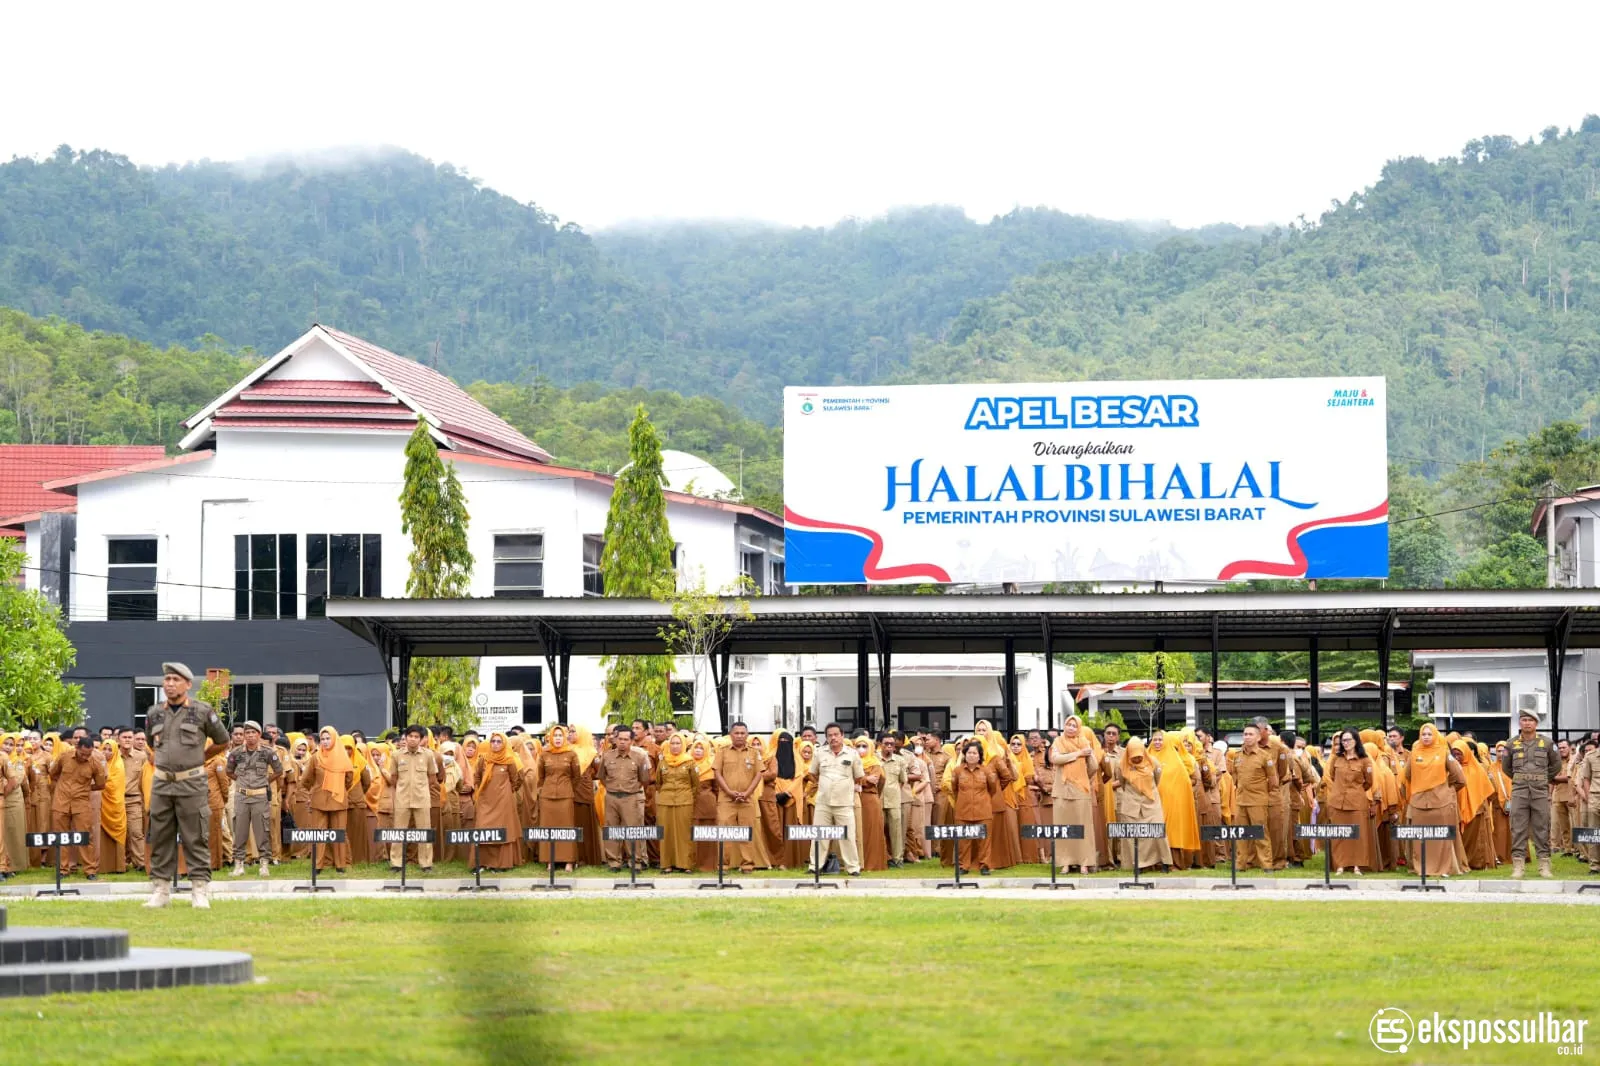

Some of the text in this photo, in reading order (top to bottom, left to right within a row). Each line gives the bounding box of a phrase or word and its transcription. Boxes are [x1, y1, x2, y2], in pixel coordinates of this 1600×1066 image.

[1334, 389, 1359, 398] MAJU
[1327, 398, 1375, 407] SEJAHTERA
[964, 395, 1200, 430] APEL BESAR
[1033, 441, 1134, 459] Dirangkaikan
[903, 507, 1266, 524] PEMERINTAH PROVINSI SULAWESI BARAT
[292, 830, 337, 841] KOMINFO
[381, 830, 428, 841] DINAS ESDM
[451, 830, 502, 843] DUK CAPIL
[528, 828, 577, 840] DINAS DIKBUD
[608, 826, 626, 840] DINAS
[693, 826, 750, 840] DINAS PANGAN
[789, 826, 845, 839] DINAS TPHP
[1221, 827, 1245, 839] DKP
